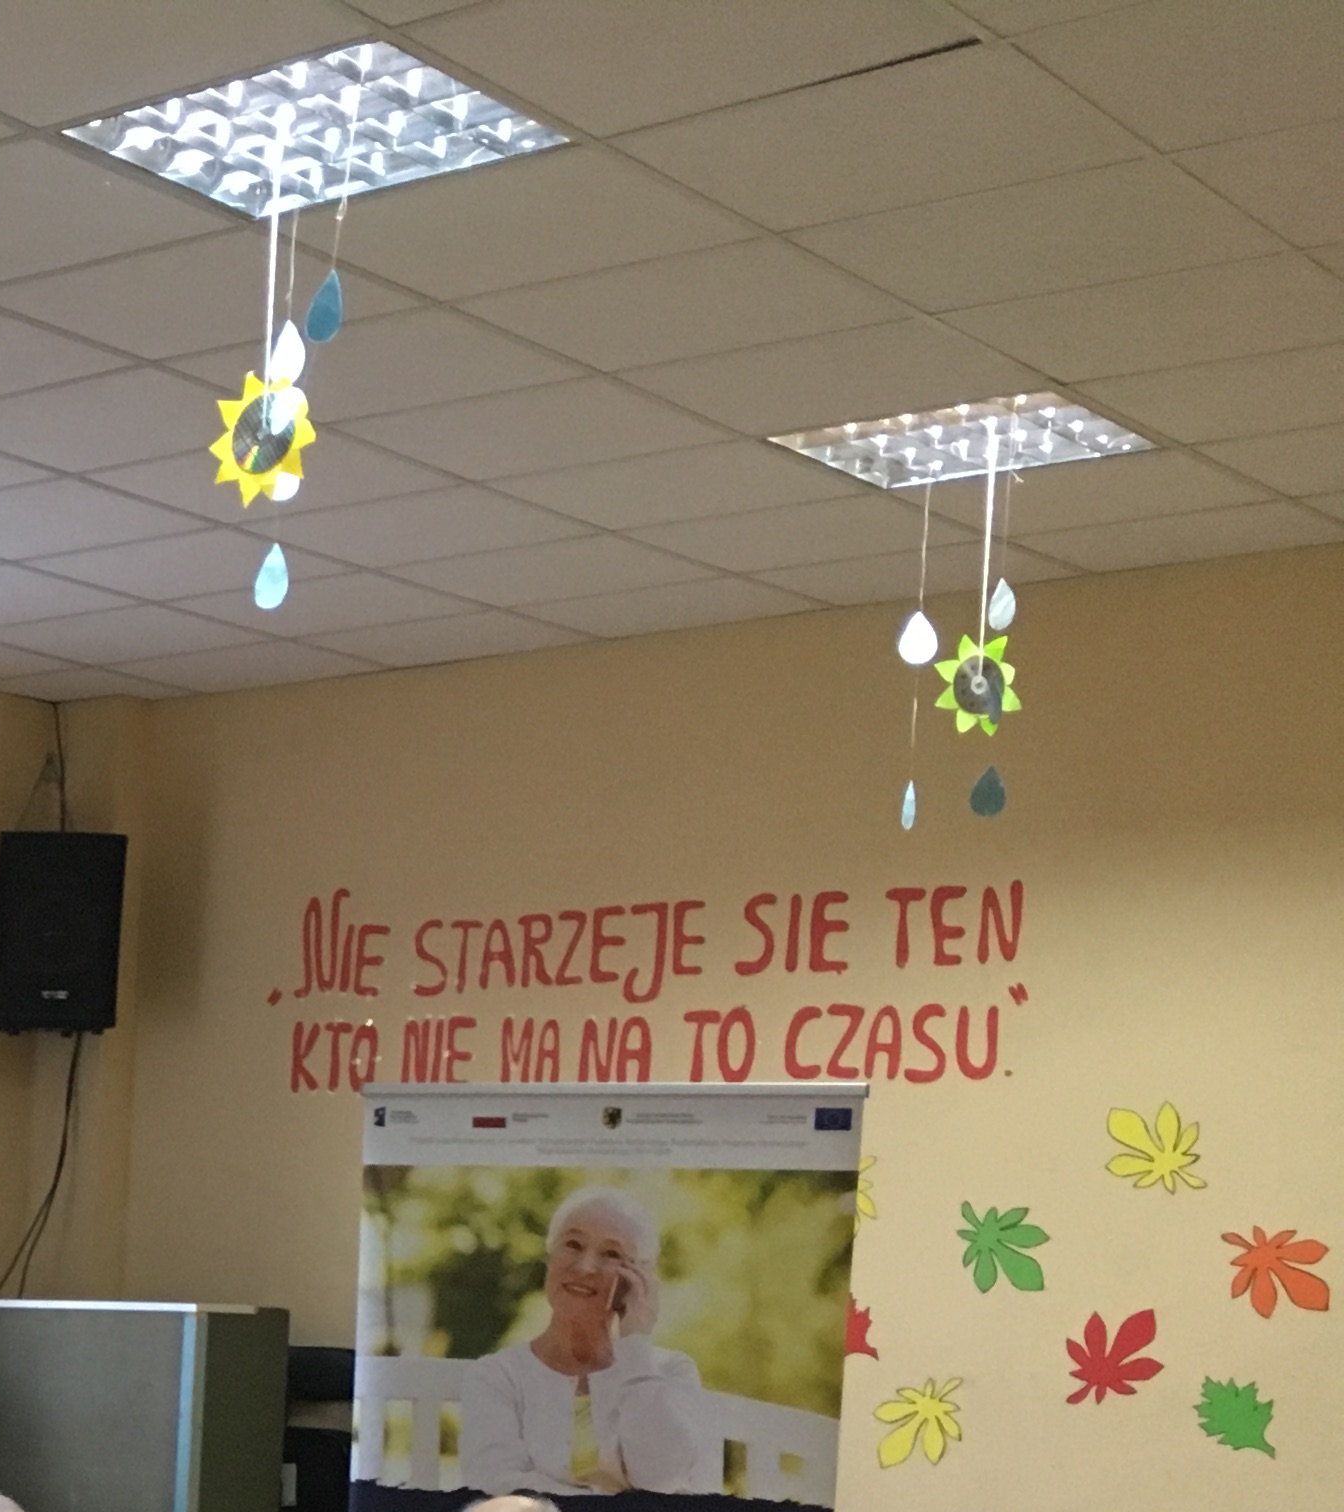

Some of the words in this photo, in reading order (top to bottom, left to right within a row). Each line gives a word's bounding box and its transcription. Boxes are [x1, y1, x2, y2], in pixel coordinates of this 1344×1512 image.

[413, 899, 706, 1003] STARZEJE
[734, 890, 850, 976] SIE
[885, 880, 1024, 969] TEN
[290, 1020, 379, 1093] KTO
[401, 1016, 477, 1083] NIE
[501, 1016, 561, 1083] MA
[578, 1016, 652, 1083] NA
[683, 1005, 756, 1083] TO
